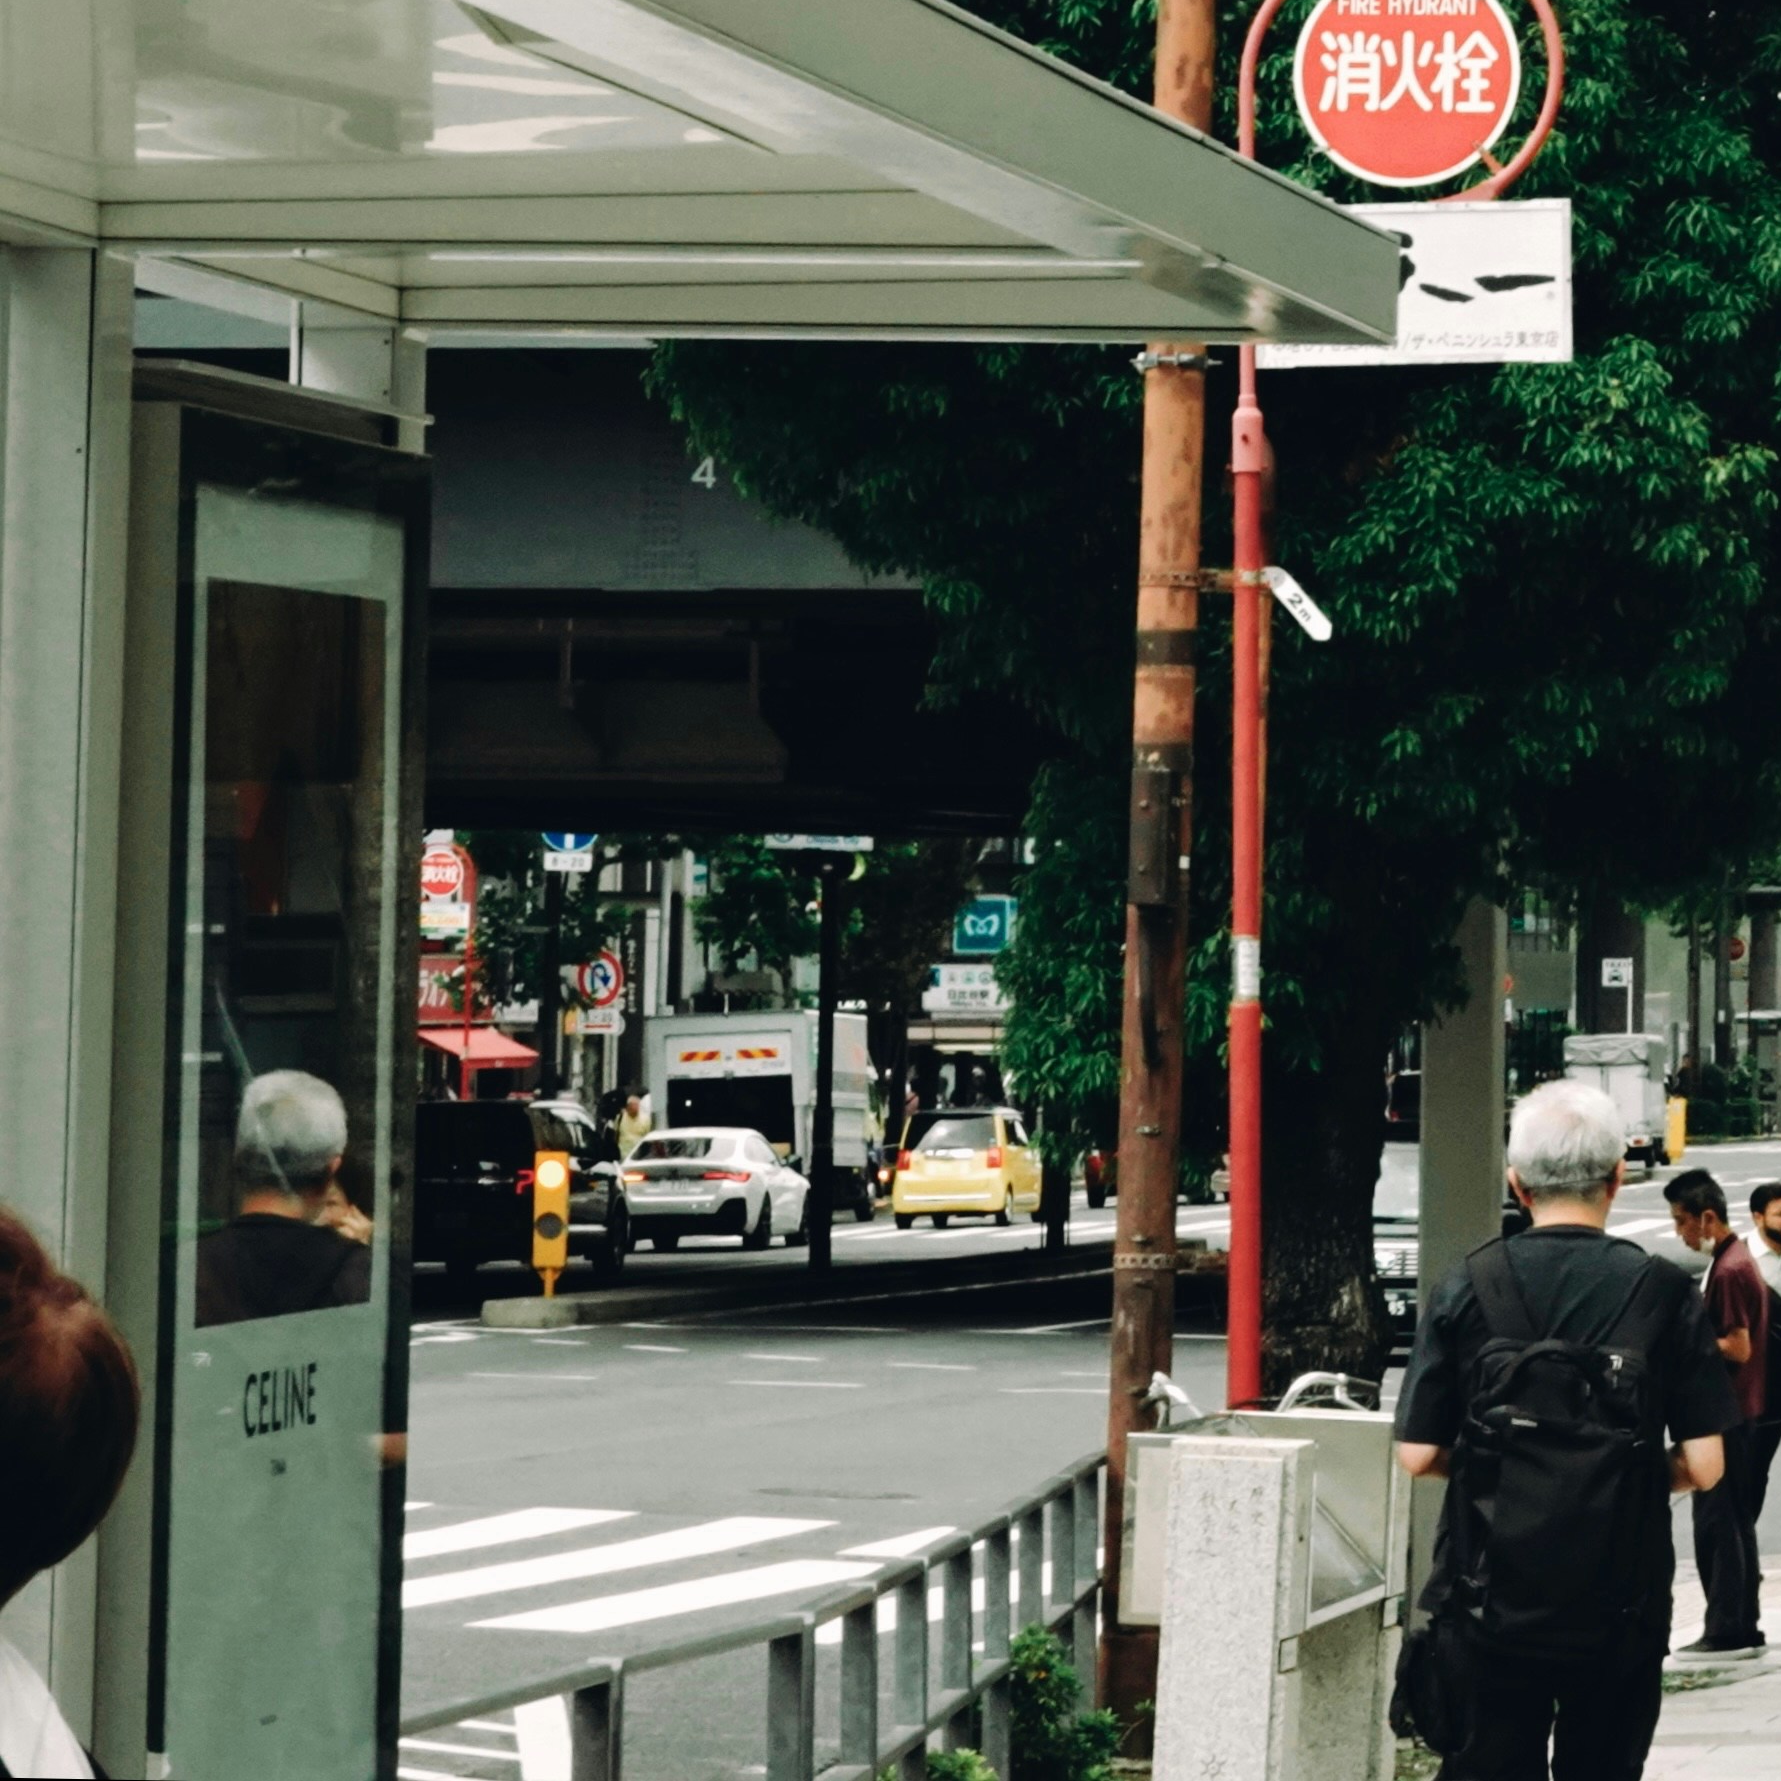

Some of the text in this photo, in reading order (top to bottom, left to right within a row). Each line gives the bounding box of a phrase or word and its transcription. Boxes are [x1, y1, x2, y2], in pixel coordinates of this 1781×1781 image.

[1318, 29, 1499, 113] 消火栓
[691, 456, 717, 489] 4
[243, 1361, 317, 1439] CELINE
